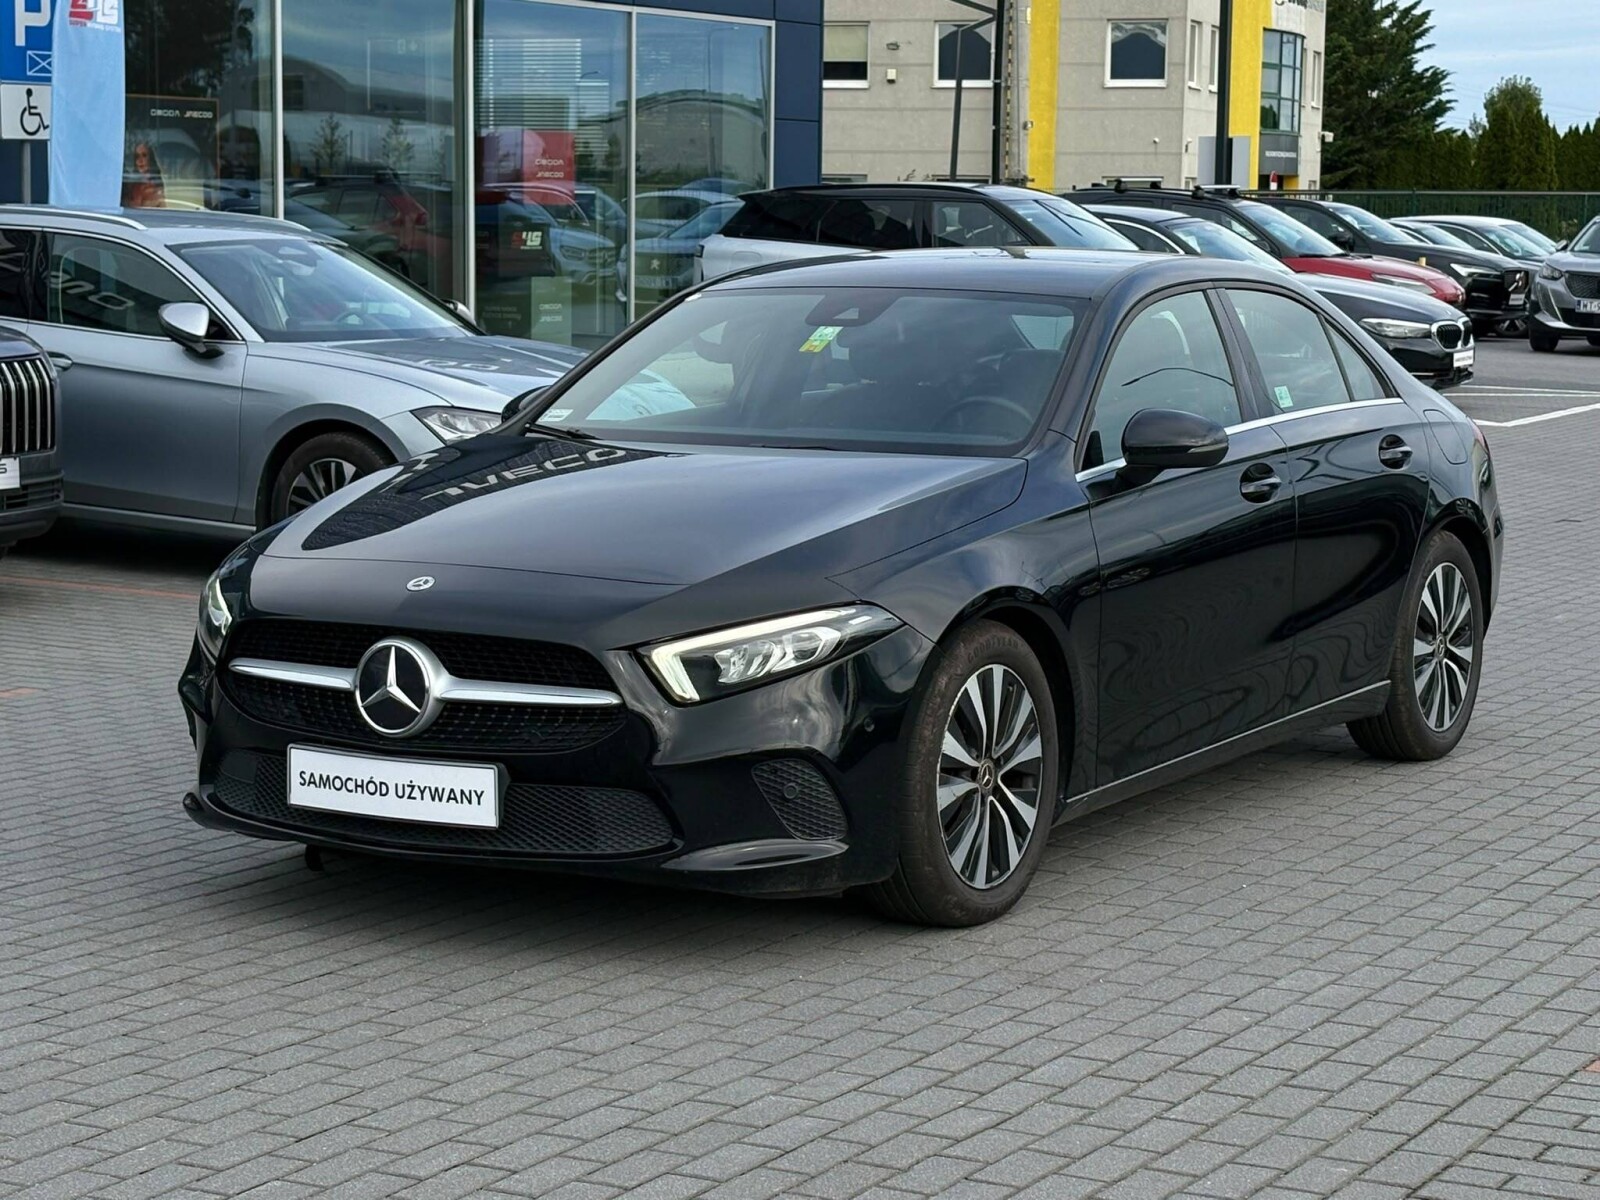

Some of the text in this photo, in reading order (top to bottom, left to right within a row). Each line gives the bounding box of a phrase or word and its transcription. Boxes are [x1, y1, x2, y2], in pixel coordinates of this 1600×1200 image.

[14, 0, 51, 46] P
[299, 770, 485, 806] SAMOCHÓD UŻYWANY
